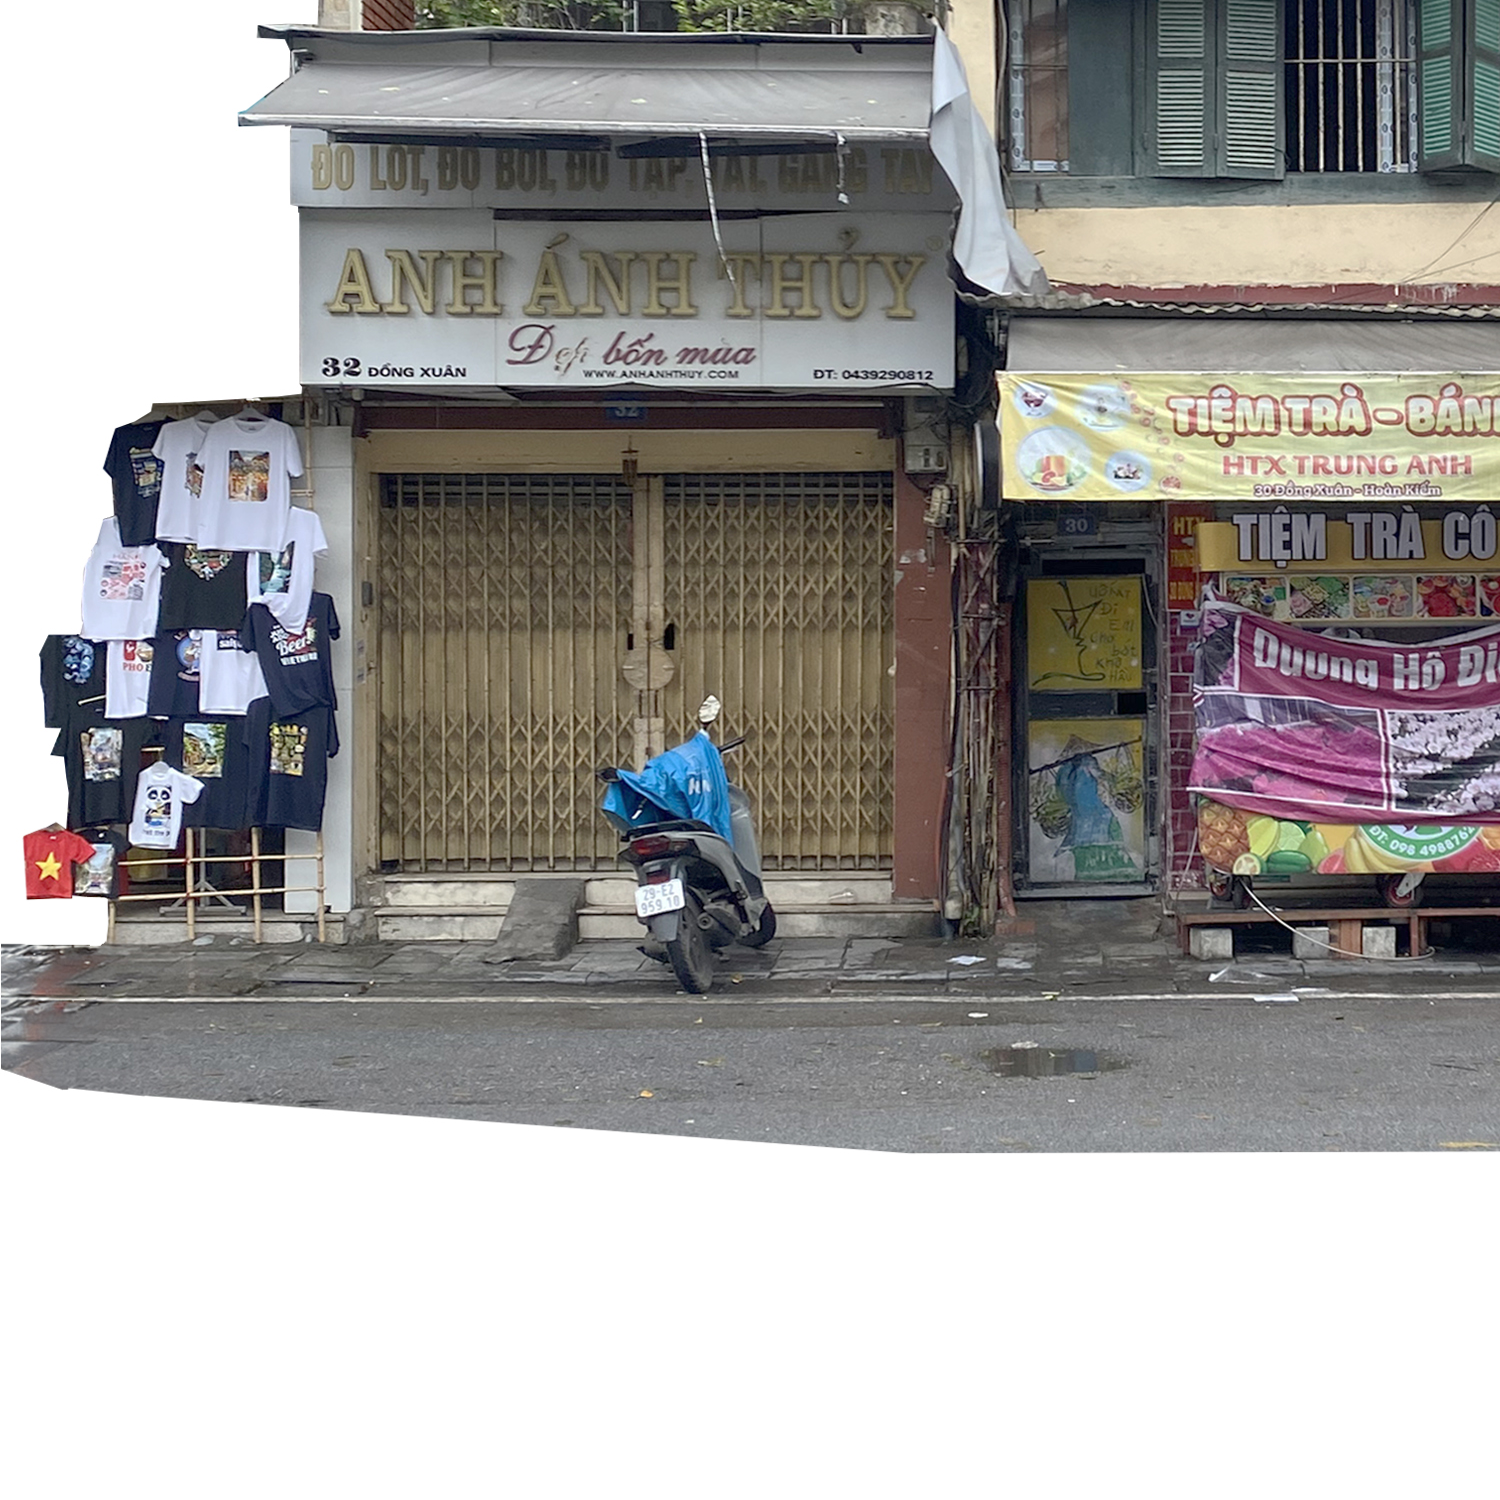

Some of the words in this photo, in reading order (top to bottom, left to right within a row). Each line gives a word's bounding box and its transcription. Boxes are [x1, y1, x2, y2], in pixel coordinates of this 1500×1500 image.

[324, 248, 503, 315] ANH
[523, 232, 697, 316] ÁNH
[602, 330, 668, 367] bốn
[321, 356, 362, 378] 32
[420, 364, 467, 378] XUÂN
[813, 369, 838, 381] ĐT:
[841, 369, 934, 382] 0439290812
[1165, 383, 1281, 447] TIỆM
[1281, 382, 1373, 438] TRÀ
[1222, 454, 1287, 476] HTX
[1290, 454, 1398, 476] TRUNG
[1405, 454, 1472, 476] ANH
[1254, 484, 1273, 497] 30
[1312, 483, 1353, 497] Xuân
[1363, 482, 1400, 497] Hoàn
[1065, 518, 1088, 533] 30
[1231, 505, 1328, 569] TIỆM
[1346, 504, 1426, 560] TRÀ
[1442, 503, 1497, 560] CÔ
[123, 661, 144, 672] PHO
[1389, 839, 1416, 856] 098
[643, 882, 675, 901] 29-E2
